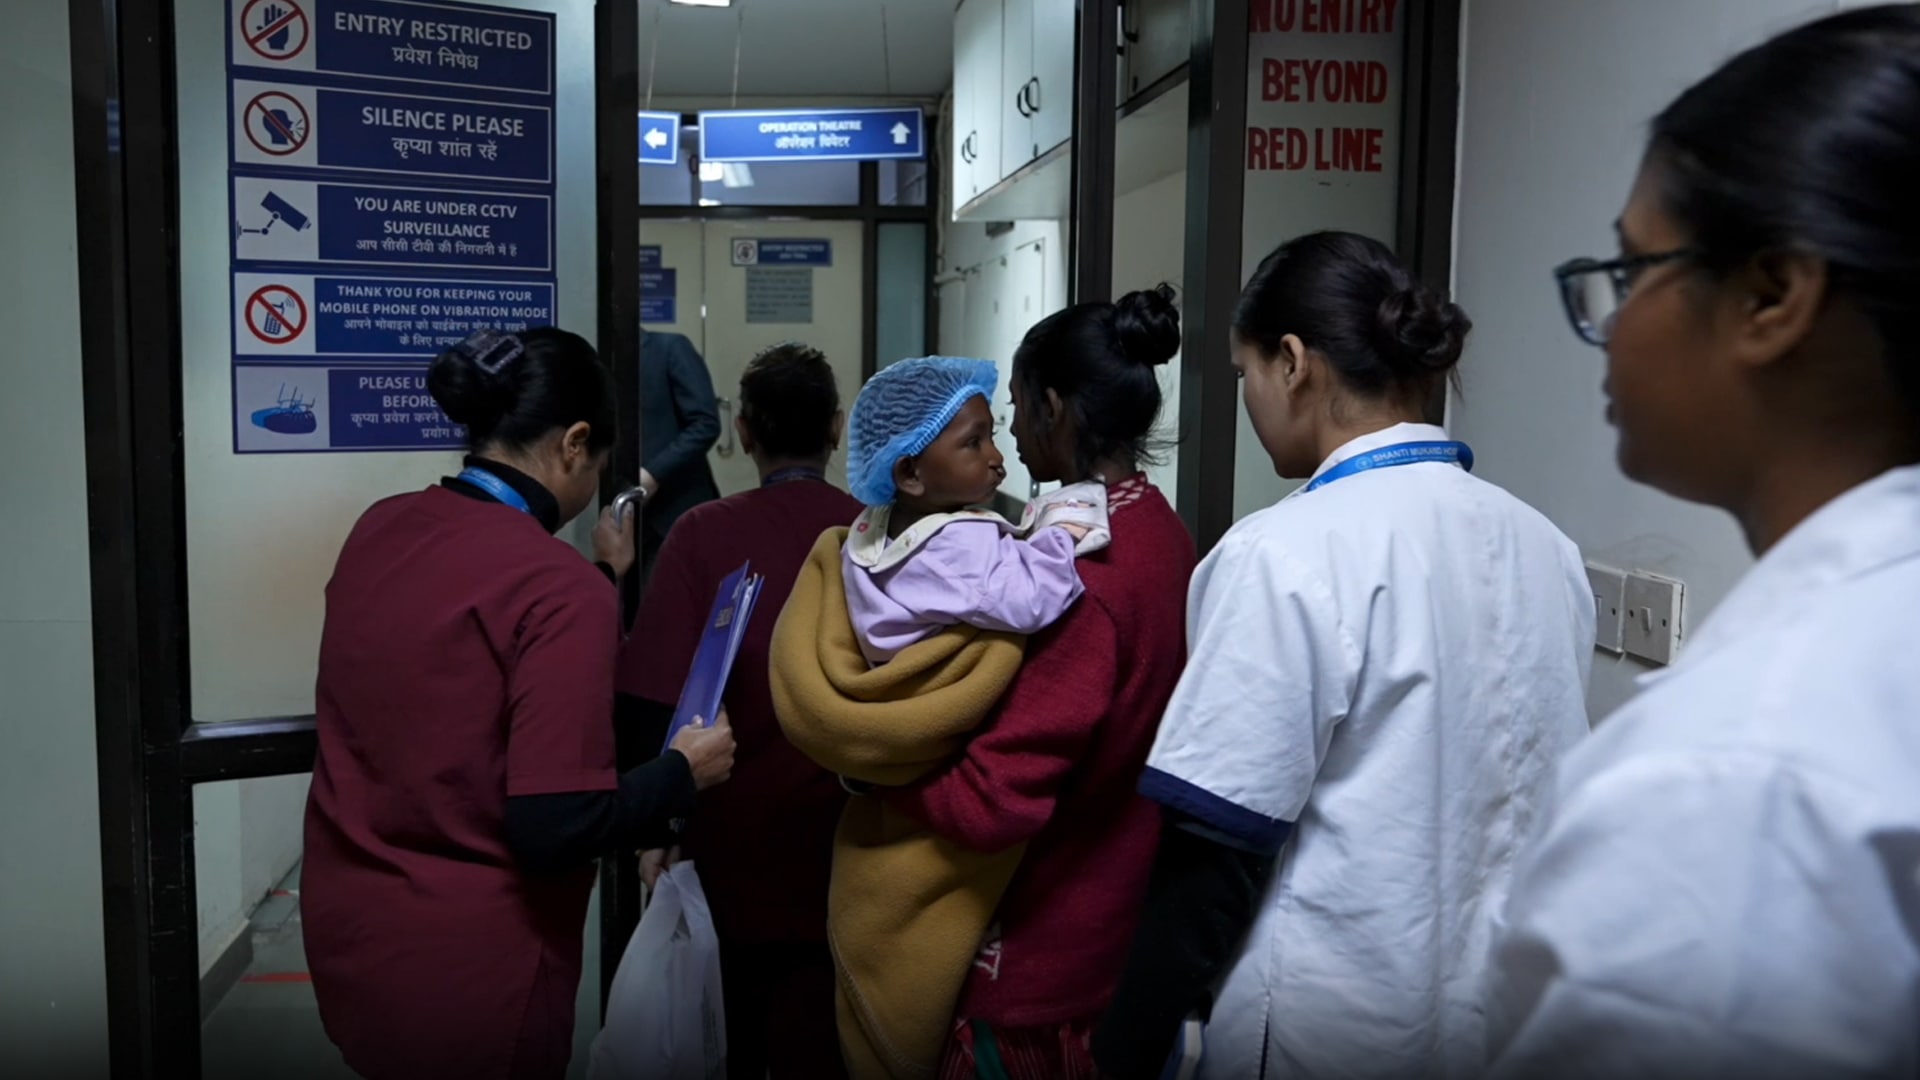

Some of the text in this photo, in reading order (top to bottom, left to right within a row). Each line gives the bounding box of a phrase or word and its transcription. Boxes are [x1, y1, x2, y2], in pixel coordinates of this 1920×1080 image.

[1250, 0, 1397, 33] NO ENTRY
[334, 11, 532, 51] ENTRY RESTRICTED
[392, 43, 479, 70] प्रवेश निषेध
[1262, 57, 1388, 104] BEYOND
[361, 105, 524, 137] SILENCE PLEASE
[758, 119, 862, 134] OPERATION THEATRE
[392, 136, 498, 160] कृप्या शांत रहें
[1247, 127, 1383, 173] RED LINE
[354, 196, 517, 219] YOU ARE UNDER CCTV
[383, 219, 491, 238] SURVEILLANCE
[356, 239, 378, 251] आप
[381, 237, 408, 252] सीसी
[411, 238, 434, 253] टीवी
[438, 239, 452, 254] की
[455, 240, 495, 256] निगरानी
[336, 285, 532, 302] THANK YOU FOR KEEPING YOUR
[319, 301, 548, 319] MOBILE PHONE ON VIBRATION MODE
[359, 376, 411, 390] PLEASE
[382, 395, 438, 408] BEFORE
[382, 409, 411, 424] प्रवेश
[413, 409, 439, 424] करने
[421, 425, 450, 439] प्रयोग
[1372, 449, 1409, 463] SHANTI
